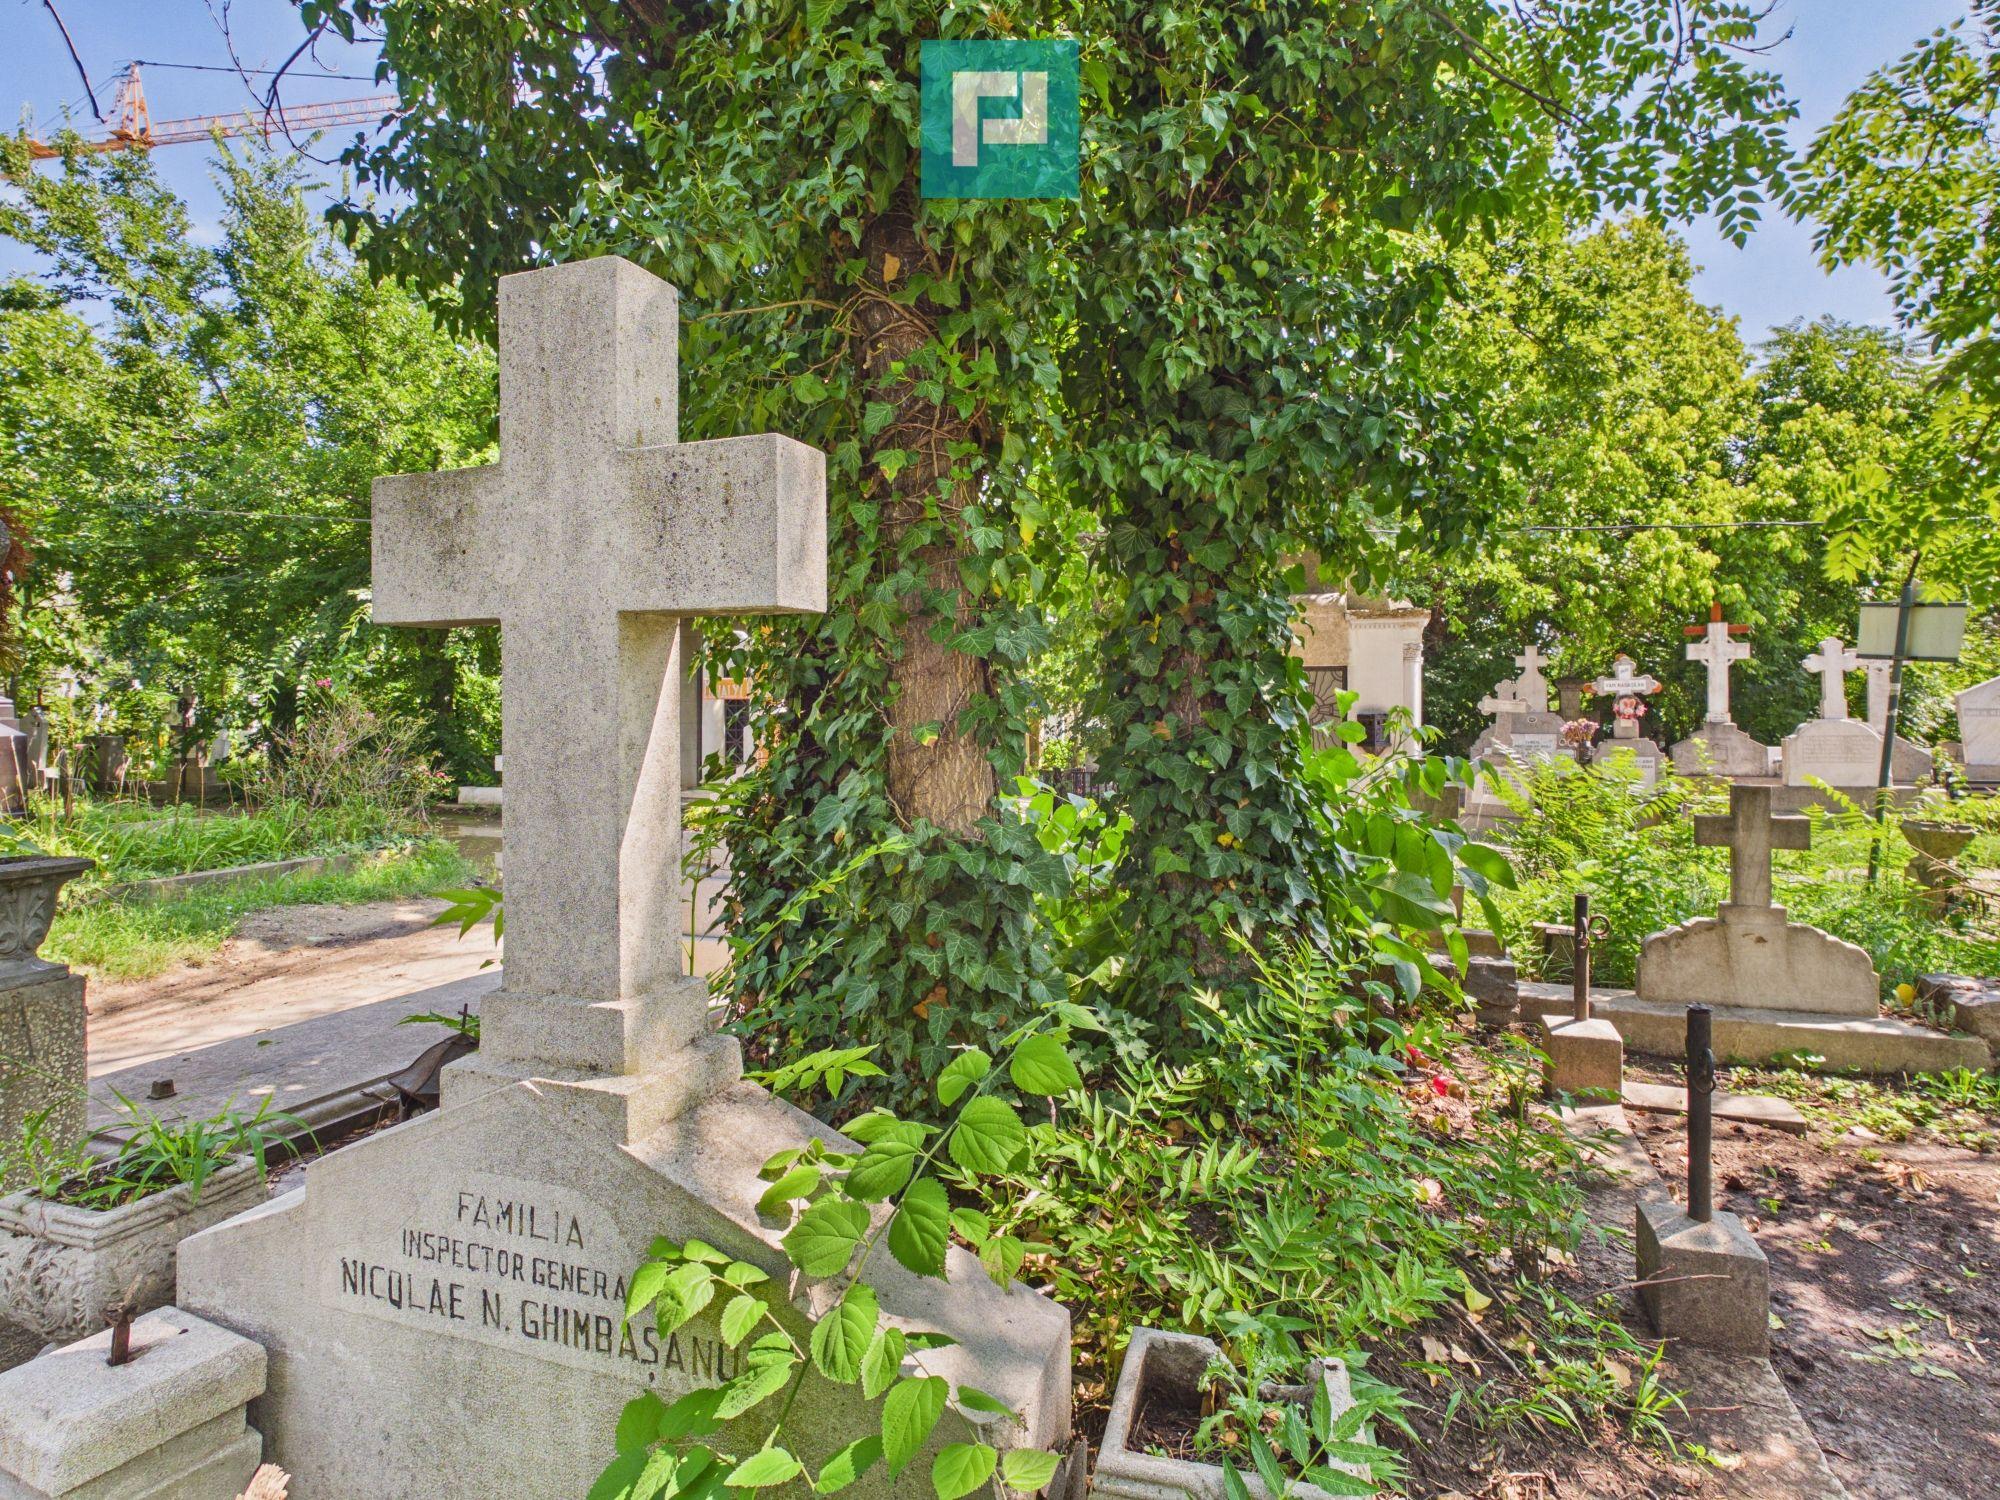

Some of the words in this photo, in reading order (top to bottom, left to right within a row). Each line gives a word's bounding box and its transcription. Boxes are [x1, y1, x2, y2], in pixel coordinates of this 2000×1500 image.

[457, 1191, 584, 1250] FAMILIA
[401, 1228, 525, 1283] INSPECTOR
[531, 1256, 628, 1304] GENERA
[340, 1256, 465, 1321] NICOLAE
[481, 1288, 511, 1334] N.
[520, 1299, 739, 1384] GHIMBAȘANU
